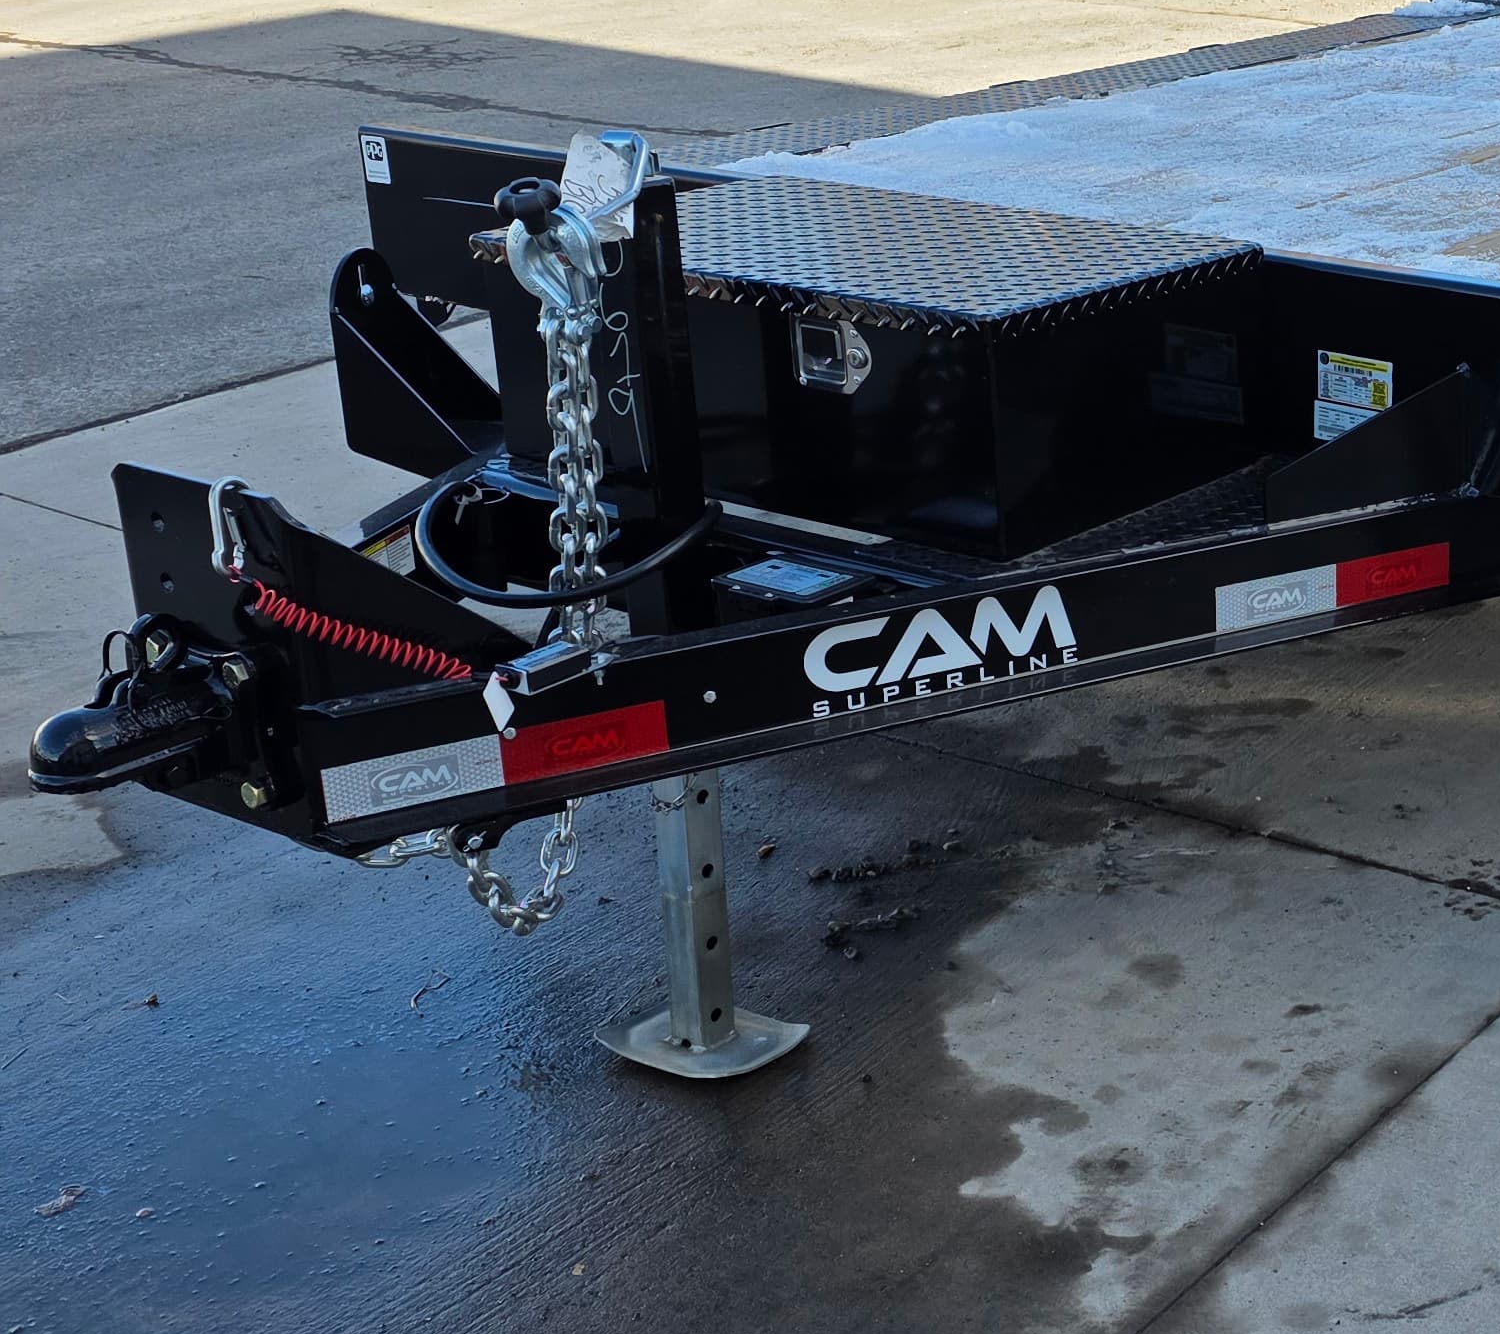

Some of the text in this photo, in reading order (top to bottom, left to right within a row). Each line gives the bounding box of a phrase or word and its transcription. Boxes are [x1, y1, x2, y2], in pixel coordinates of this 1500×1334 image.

[1371, 564, 1417, 584] CAM
[1253, 588, 1302, 611] CAM
[803, 585, 1077, 692] CAM
[812, 647, 1078, 717] SUPERLINE
[551, 729, 620, 757] CAM
[378, 764, 452, 793] CAM
